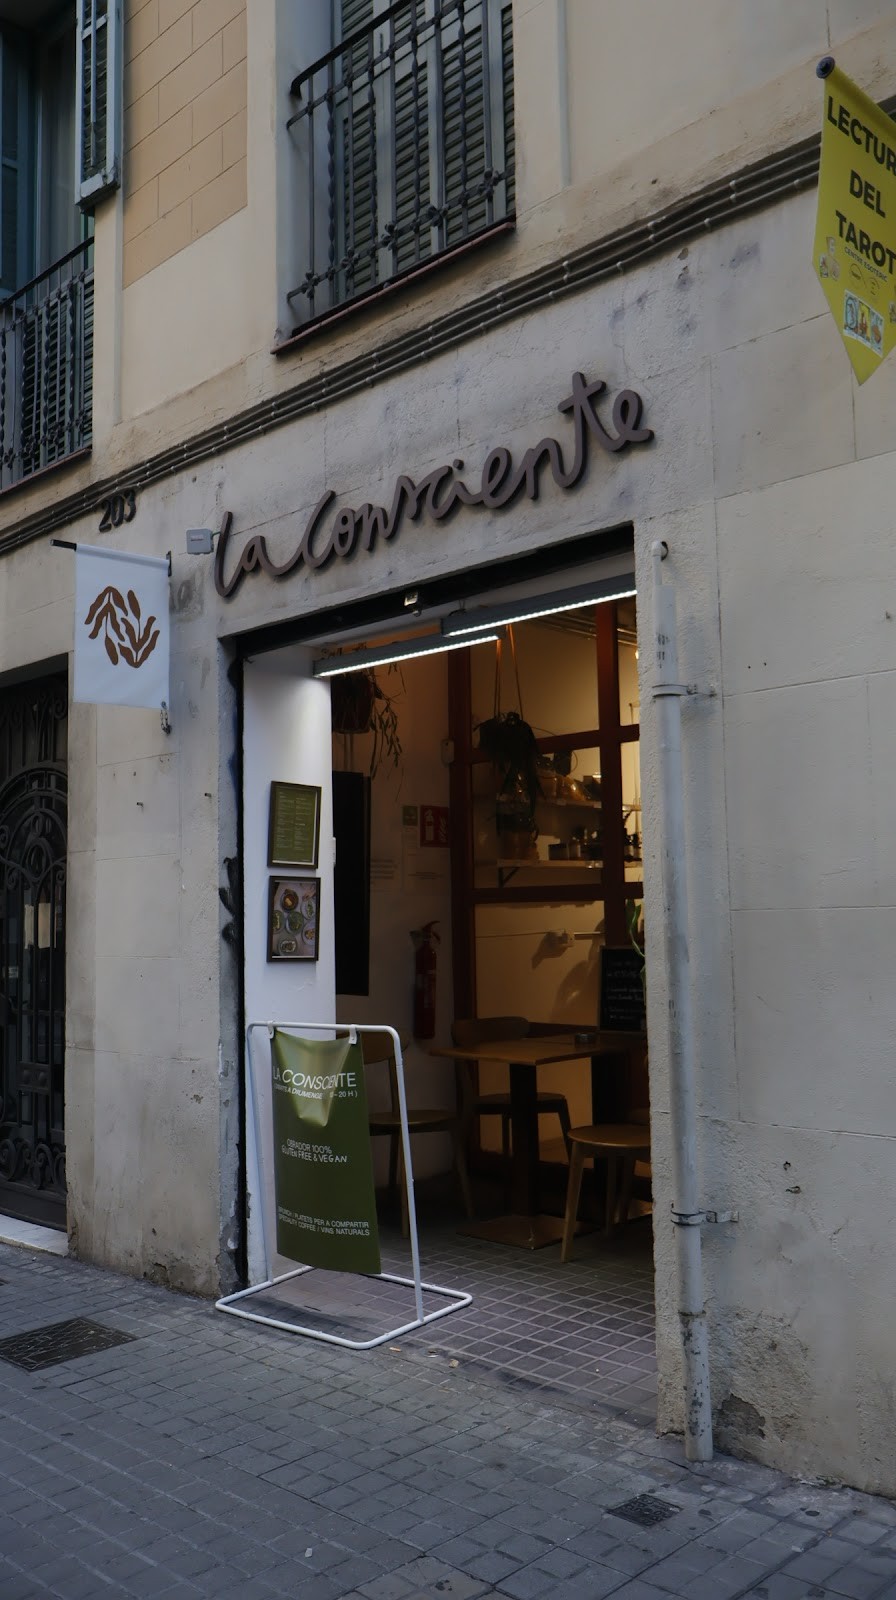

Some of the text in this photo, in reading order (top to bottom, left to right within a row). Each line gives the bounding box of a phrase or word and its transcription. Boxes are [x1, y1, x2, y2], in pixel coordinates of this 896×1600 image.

[850, 169, 886, 219] DEL
[835, 210, 896, 275] TAROT
[98, 489, 137, 532] 203
[298, 1150, 312, 1161] FREE
[318, 1154, 348, 1163] VEGAN
[311, 1144, 332, 1154] 100%
[297, 1221, 317, 1232] COFFEE
[320, 1227, 335, 1235] VINS
[335, 1228, 370, 1236] NATURALS
[313, 1218, 325, 1226] PER
[331, 1220, 369, 1228] COMPARTIR
